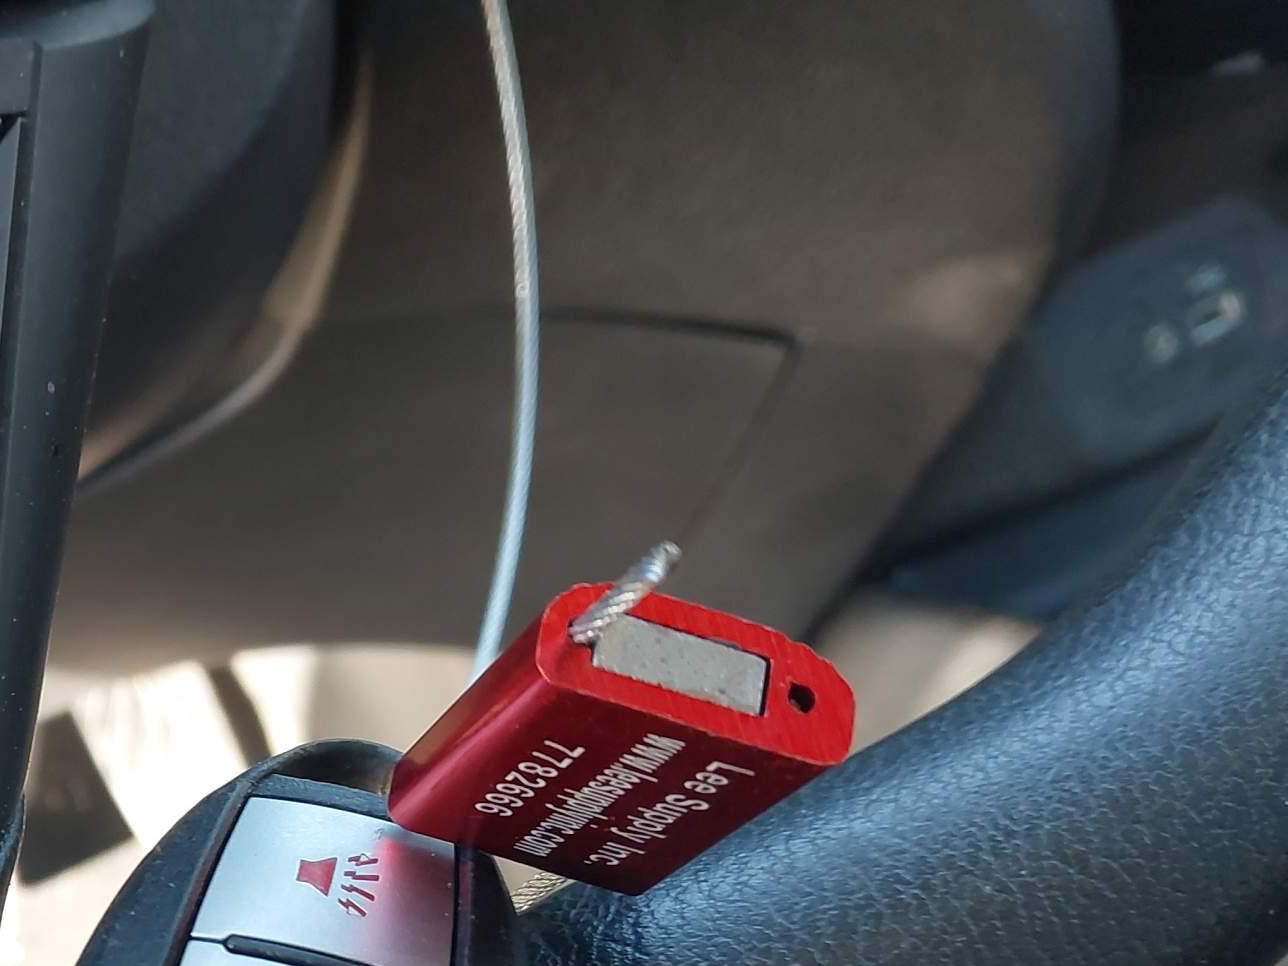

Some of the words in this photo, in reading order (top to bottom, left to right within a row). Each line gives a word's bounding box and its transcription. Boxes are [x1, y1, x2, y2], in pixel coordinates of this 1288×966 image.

[474, 740, 586, 817] 7782666
[513, 733, 687, 857] www.leesupplyinc.com
[683, 760, 756, 794] Lee
[610, 793, 710, 844] Supply
[583, 841, 646, 866] Inc.
